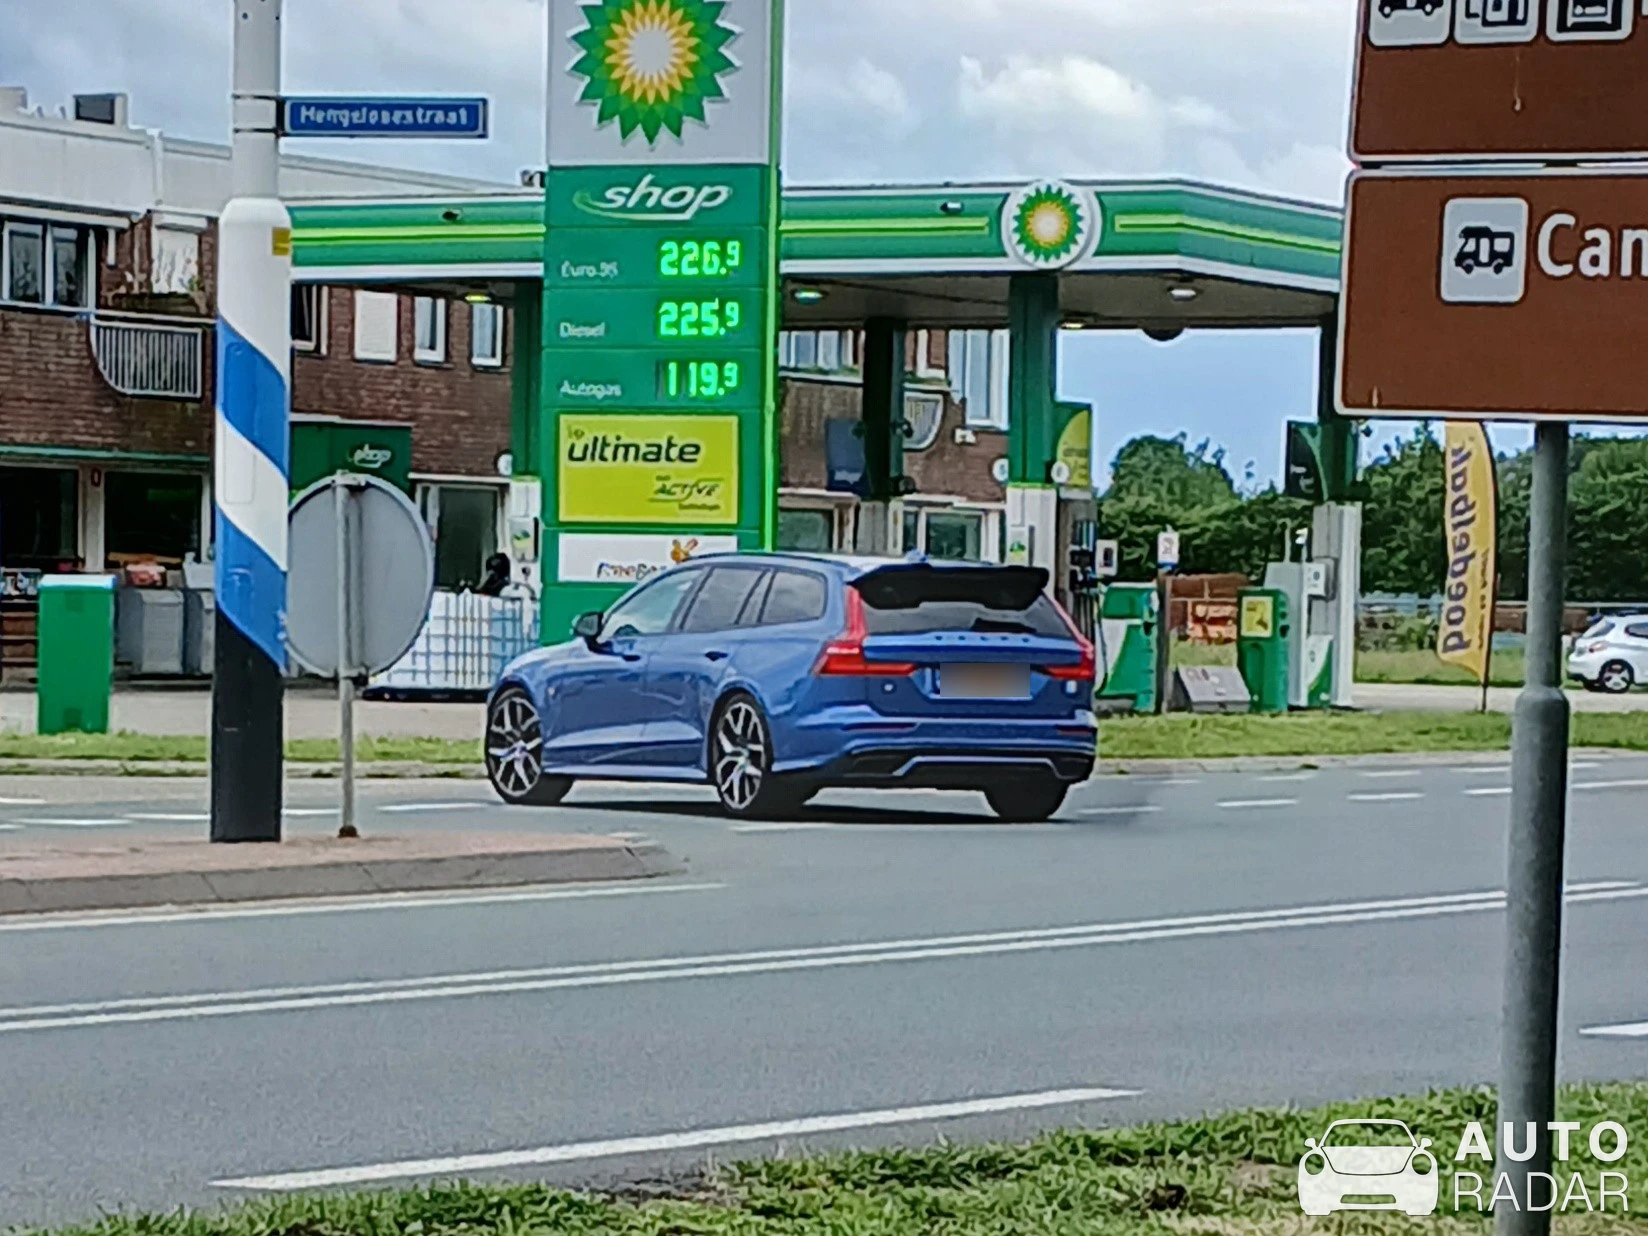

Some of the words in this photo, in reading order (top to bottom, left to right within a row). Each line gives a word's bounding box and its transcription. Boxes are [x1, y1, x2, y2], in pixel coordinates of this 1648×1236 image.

[600, 174, 733, 220] shop
[561, 260, 597, 277] Euro
[560, 321, 605, 337] Diesel
[560, 380, 621, 399] Autogas
[568, 435, 700, 462] ultimate
